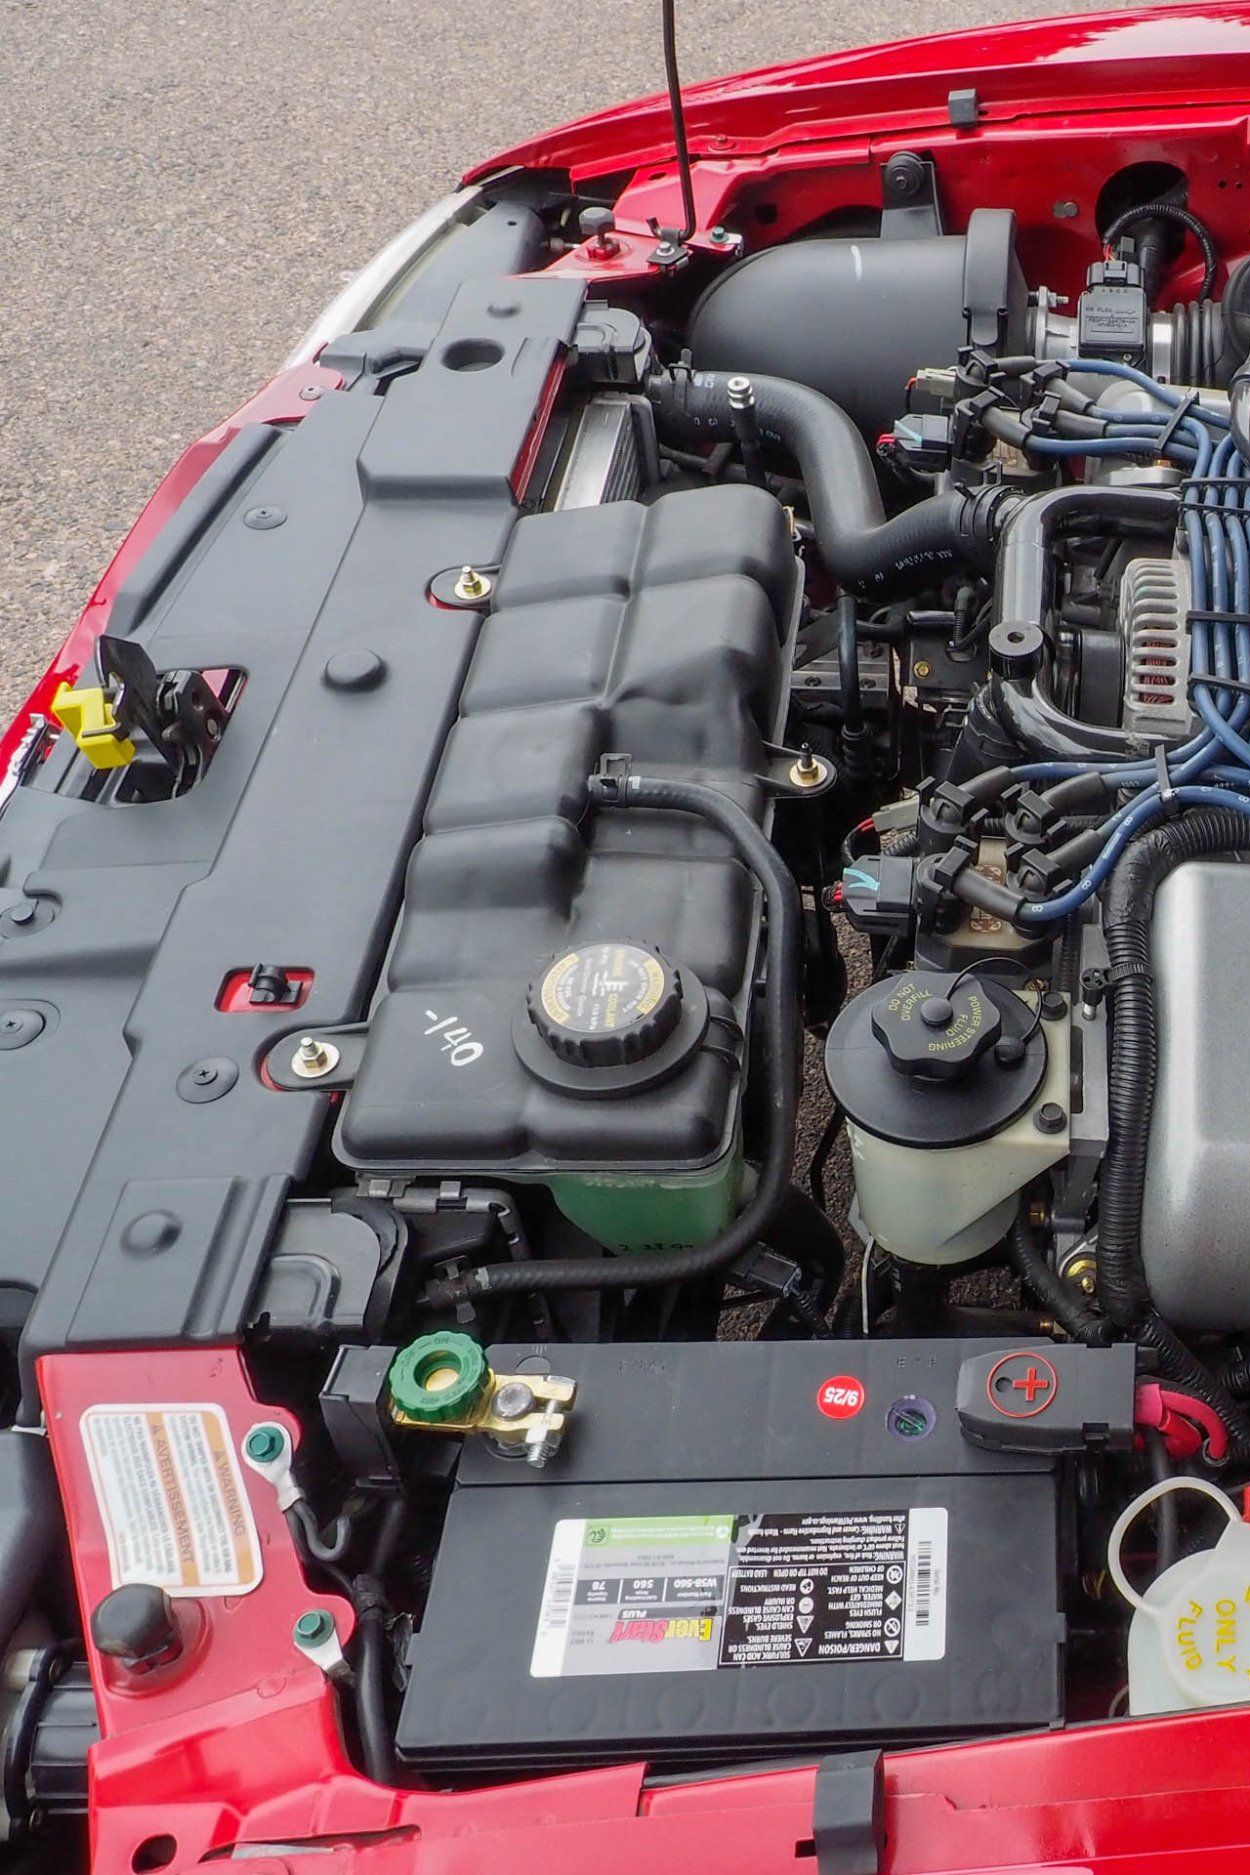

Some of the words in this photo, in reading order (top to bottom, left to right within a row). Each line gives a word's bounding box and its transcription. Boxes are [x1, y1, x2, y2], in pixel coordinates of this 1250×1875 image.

[888, 997, 900, 1012] DO
[899, 982, 917, 1000] NOT
[604, 993, 619, 1027] COOLANT
[900, 989, 934, 1022] OVERFILL
[968, 995, 984, 1028] POWER
[945, 1013, 969, 1037] FLUID
[928, 1027, 976, 1052] STEERING
[823, 1386, 859, 1407] 9/25
[155, 1439, 194, 1564] AVERTISSEMENT
[218, 1460, 247, 1538] WARNING
[731, 1569, 754, 1578] BATTERY
[753, 1569, 768, 1578] LEAD
[773, 1568, 789, 1578] OPEN
[789, 1568, 797, 1577] OR
[798, 1568, 807, 1577] TIP
[807, 1567, 819, 1576] NOT
[819, 1567, 828, 1576] DO
[849, 1565, 877, 1574] CHILDREN
[850, 1574, 858, 1582] OF
[858, 1574, 869, 1582] OUT
[870, 1573, 884, 1581] KEEP
[592, 1581, 606, 1590] 78
[633, 1579, 654, 1589] 560
[740, 1584, 780, 1593] INSTRUCTIONS
[780, 1583, 797, 1592] READ
[843, 1586, 858, 1594] HELP
[858, 1585, 883, 1593] MEDICAL
[785, 1597, 795, 1605] OR
[849, 1593, 861, 1601] GET
[762, 1605, 781, 1614] CAUSE
[781, 1605, 795, 1613] CAN
[828, 1601, 845, 1610] WITH
[845, 1601, 883, 1609] IMMEDIATELY
[622, 1609, 647, 1619] PLUS
[728, 1606, 761, 1615] BLINDNESS
[849, 1609, 863, 1617] EYES
[863, 1608, 883, 1617] FLUSH
[743, 1614, 762, 1623] GASES
[762, 1613, 794, 1622] EXPLOSIVE
[771, 1621, 793, 1630] SHIELD
[845, 1620, 872, 1629] SMOKING
[872, 1620, 882, 1628] OR
[610, 1618, 713, 1643] EverStart
[823, 1630, 848, 1639] FLAMES
[872, 1629, 881, 1637] NO
[770, 1634, 792, 1643] SEVERE
[1177, 1599, 1203, 1672] FLUID
[1216, 1598, 1237, 1673] ONLY
[728, 1644, 737, 1653] OR
[738, 1643, 771, 1652] BLINDNESS
[771, 1642, 791, 1651] CAUSE
[818, 1642, 881, 1655] DANGER/POISON
[732, 1652, 746, 1661] CAN
[746, 1652, 761, 1661] ACID
[762, 1651, 791, 1660] SULFURIC
